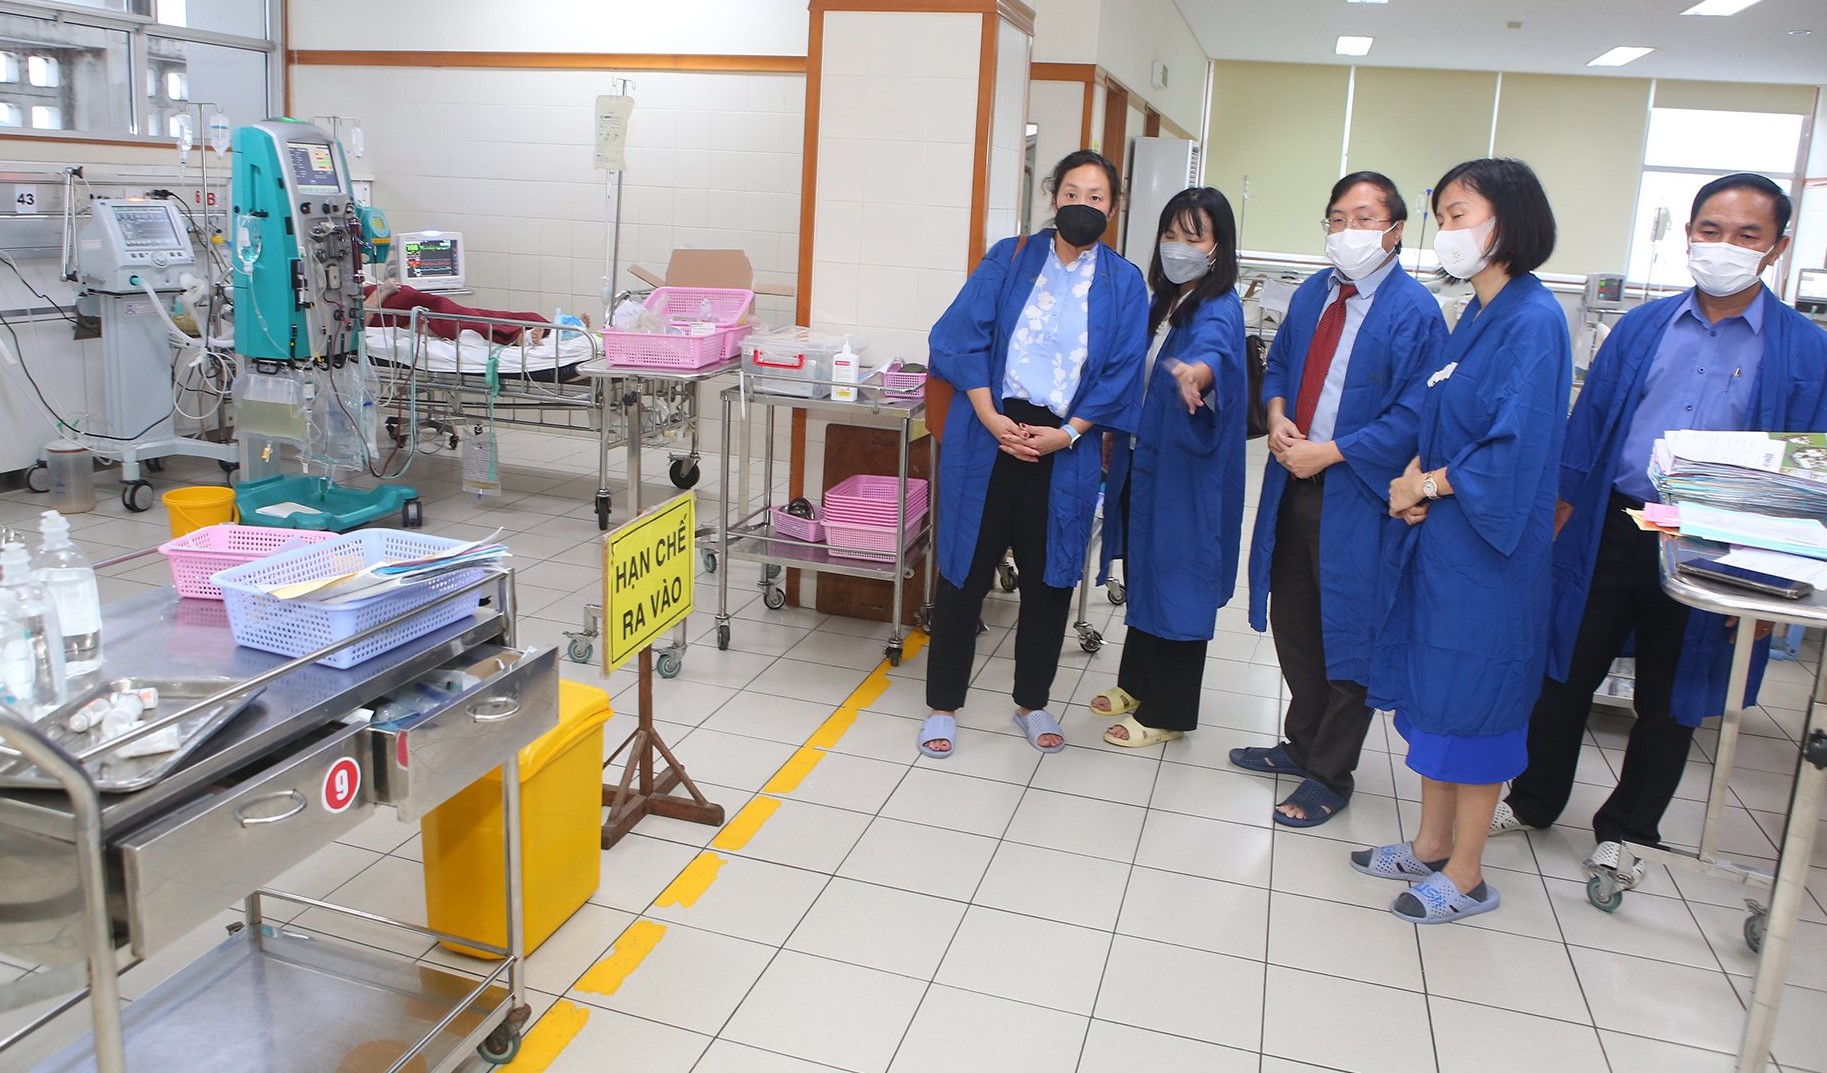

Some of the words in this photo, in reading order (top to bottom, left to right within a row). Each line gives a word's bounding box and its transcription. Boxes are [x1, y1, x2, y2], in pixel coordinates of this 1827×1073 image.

[17, 193, 35, 205] 43
[616, 547, 650, 593] HẠN
[655, 513, 688, 567] CHẾ
[623, 602, 645, 640] RA
[650, 576, 682, 618] VÀO
[335, 769, 349, 801] 9
